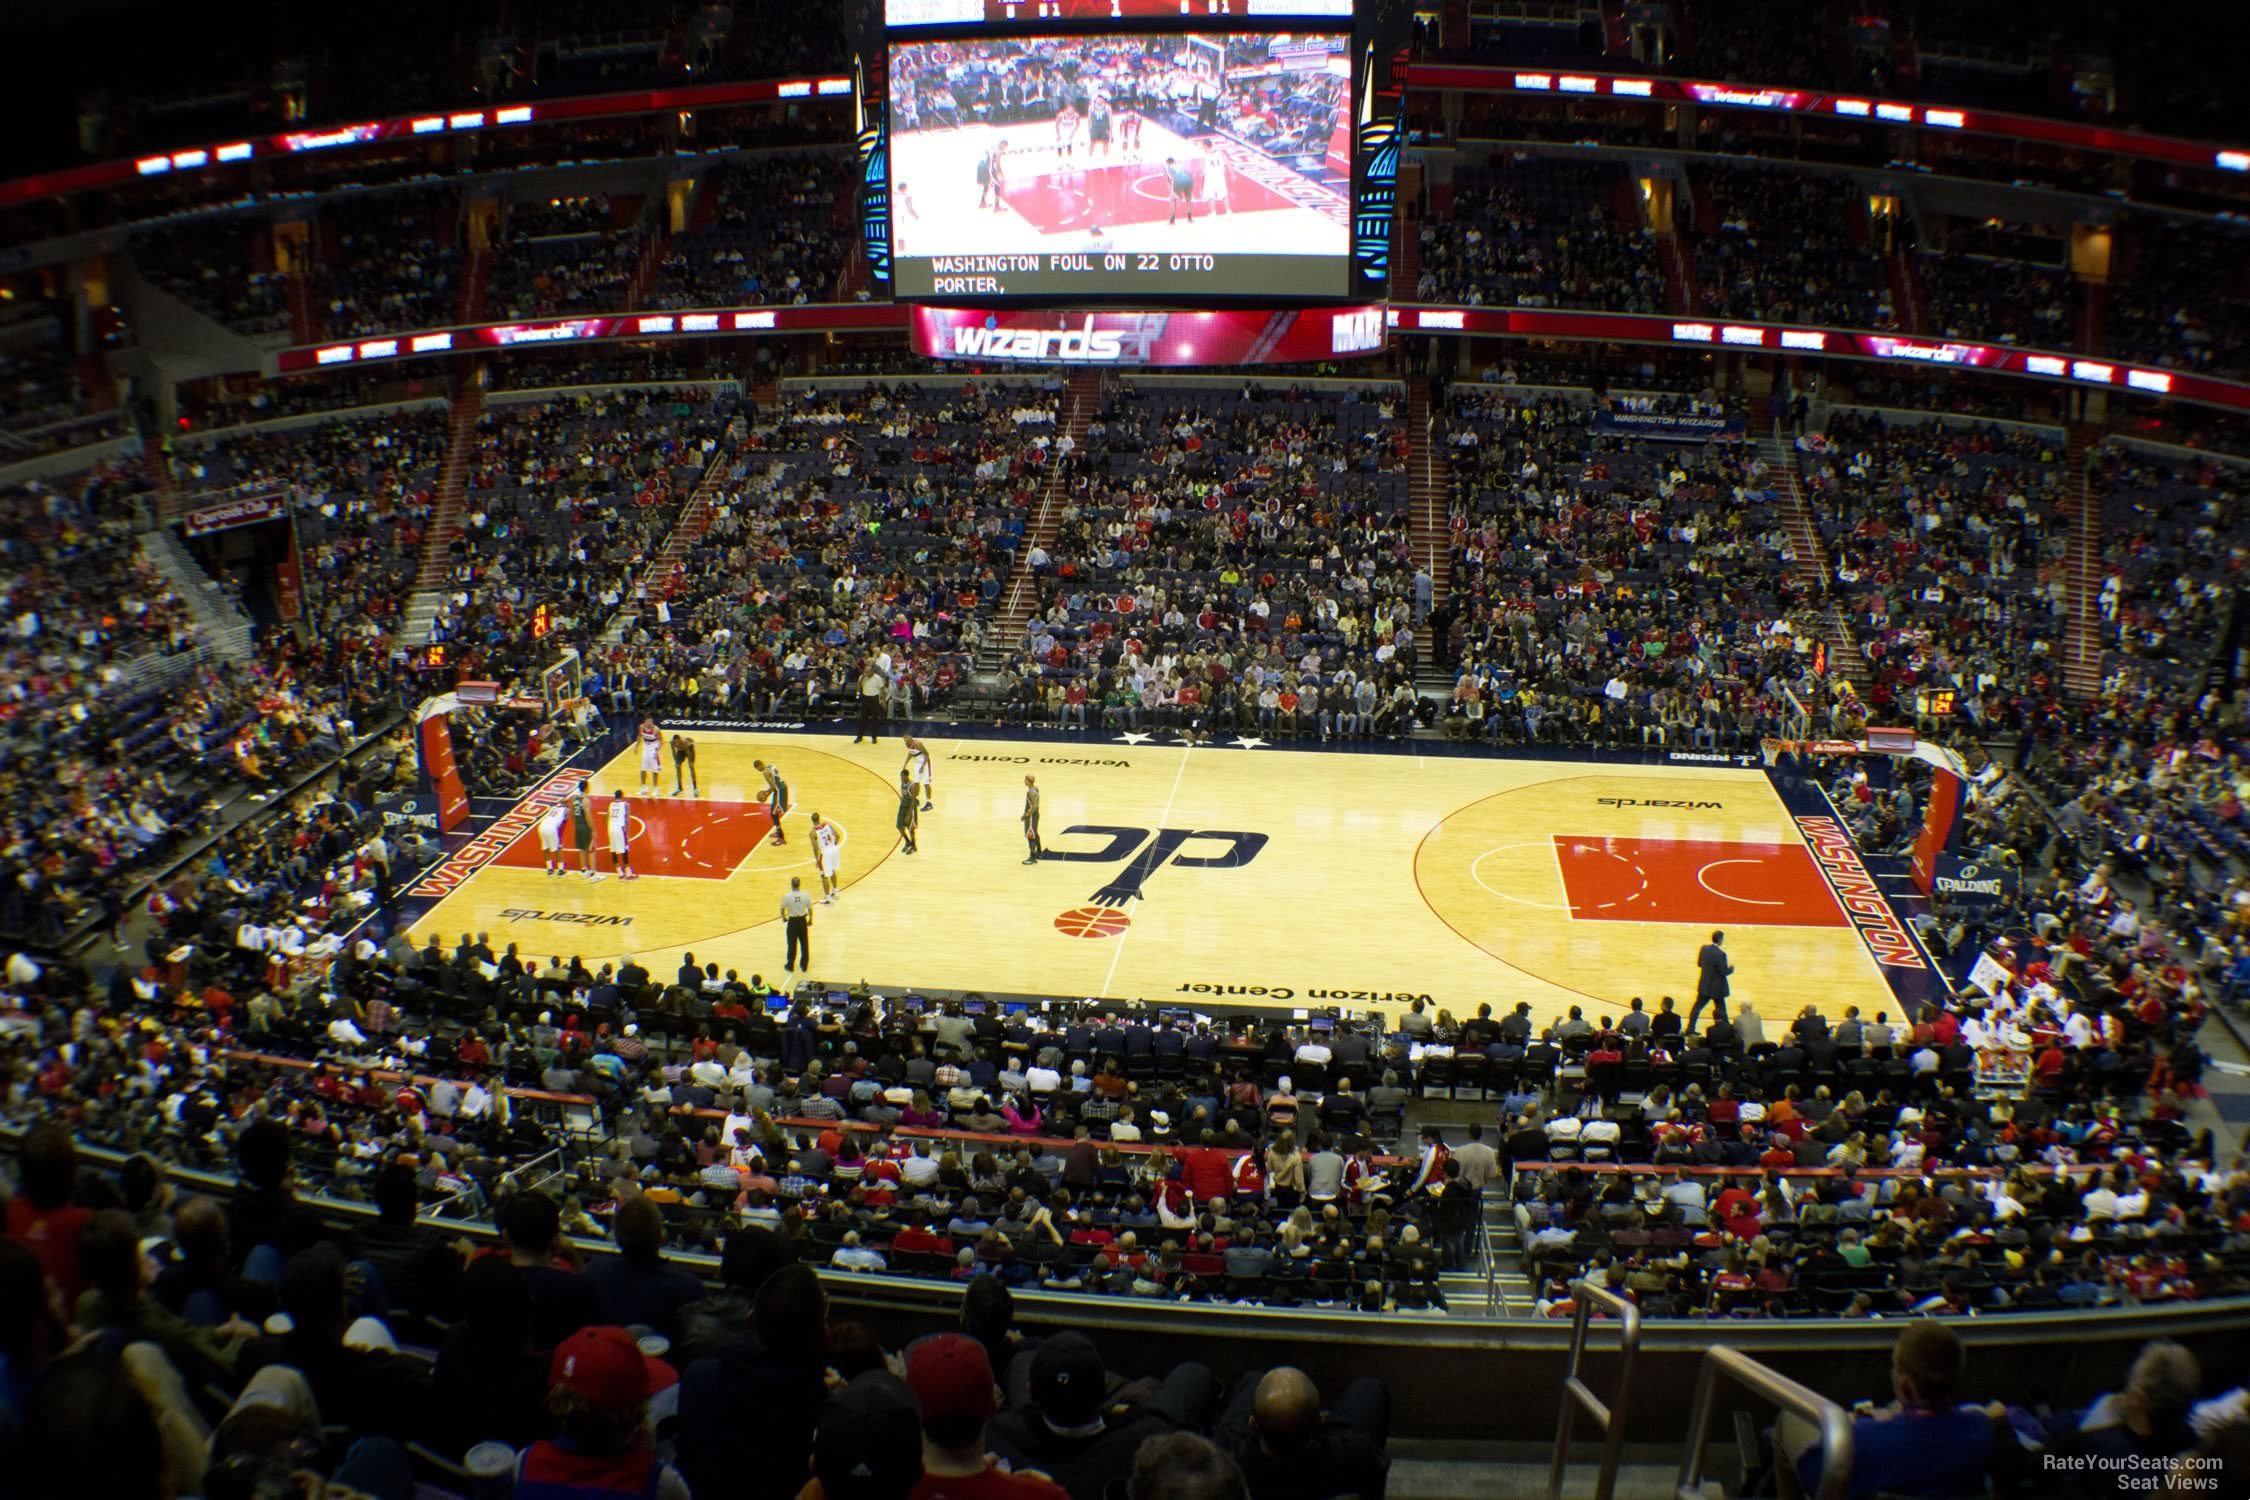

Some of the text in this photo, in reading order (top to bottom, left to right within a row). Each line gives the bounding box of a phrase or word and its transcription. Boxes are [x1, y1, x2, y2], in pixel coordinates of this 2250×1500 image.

[932, 255, 1214, 273] WASHINGTON FOUL ON 22 OTTO
[934, 278, 1005, 294] PORTER,
[955, 313, 1126, 360] wizards
[1614, 414, 1726, 428] WASHINGTON WIZARDS
[660, 719, 805, 729] @WASHWIZARDS
[946, 754, 1131, 768] Verizon Center
[1597, 796, 1722, 810] wizards
[408, 768, 595, 897] WASHINGTON
[1794, 815, 1928, 969] WASHINGTON
[1936, 876, 2002, 895] SPALDING
[496, 908, 634, 928] wizards
[1176, 983, 1437, 1007] Verizon Center
